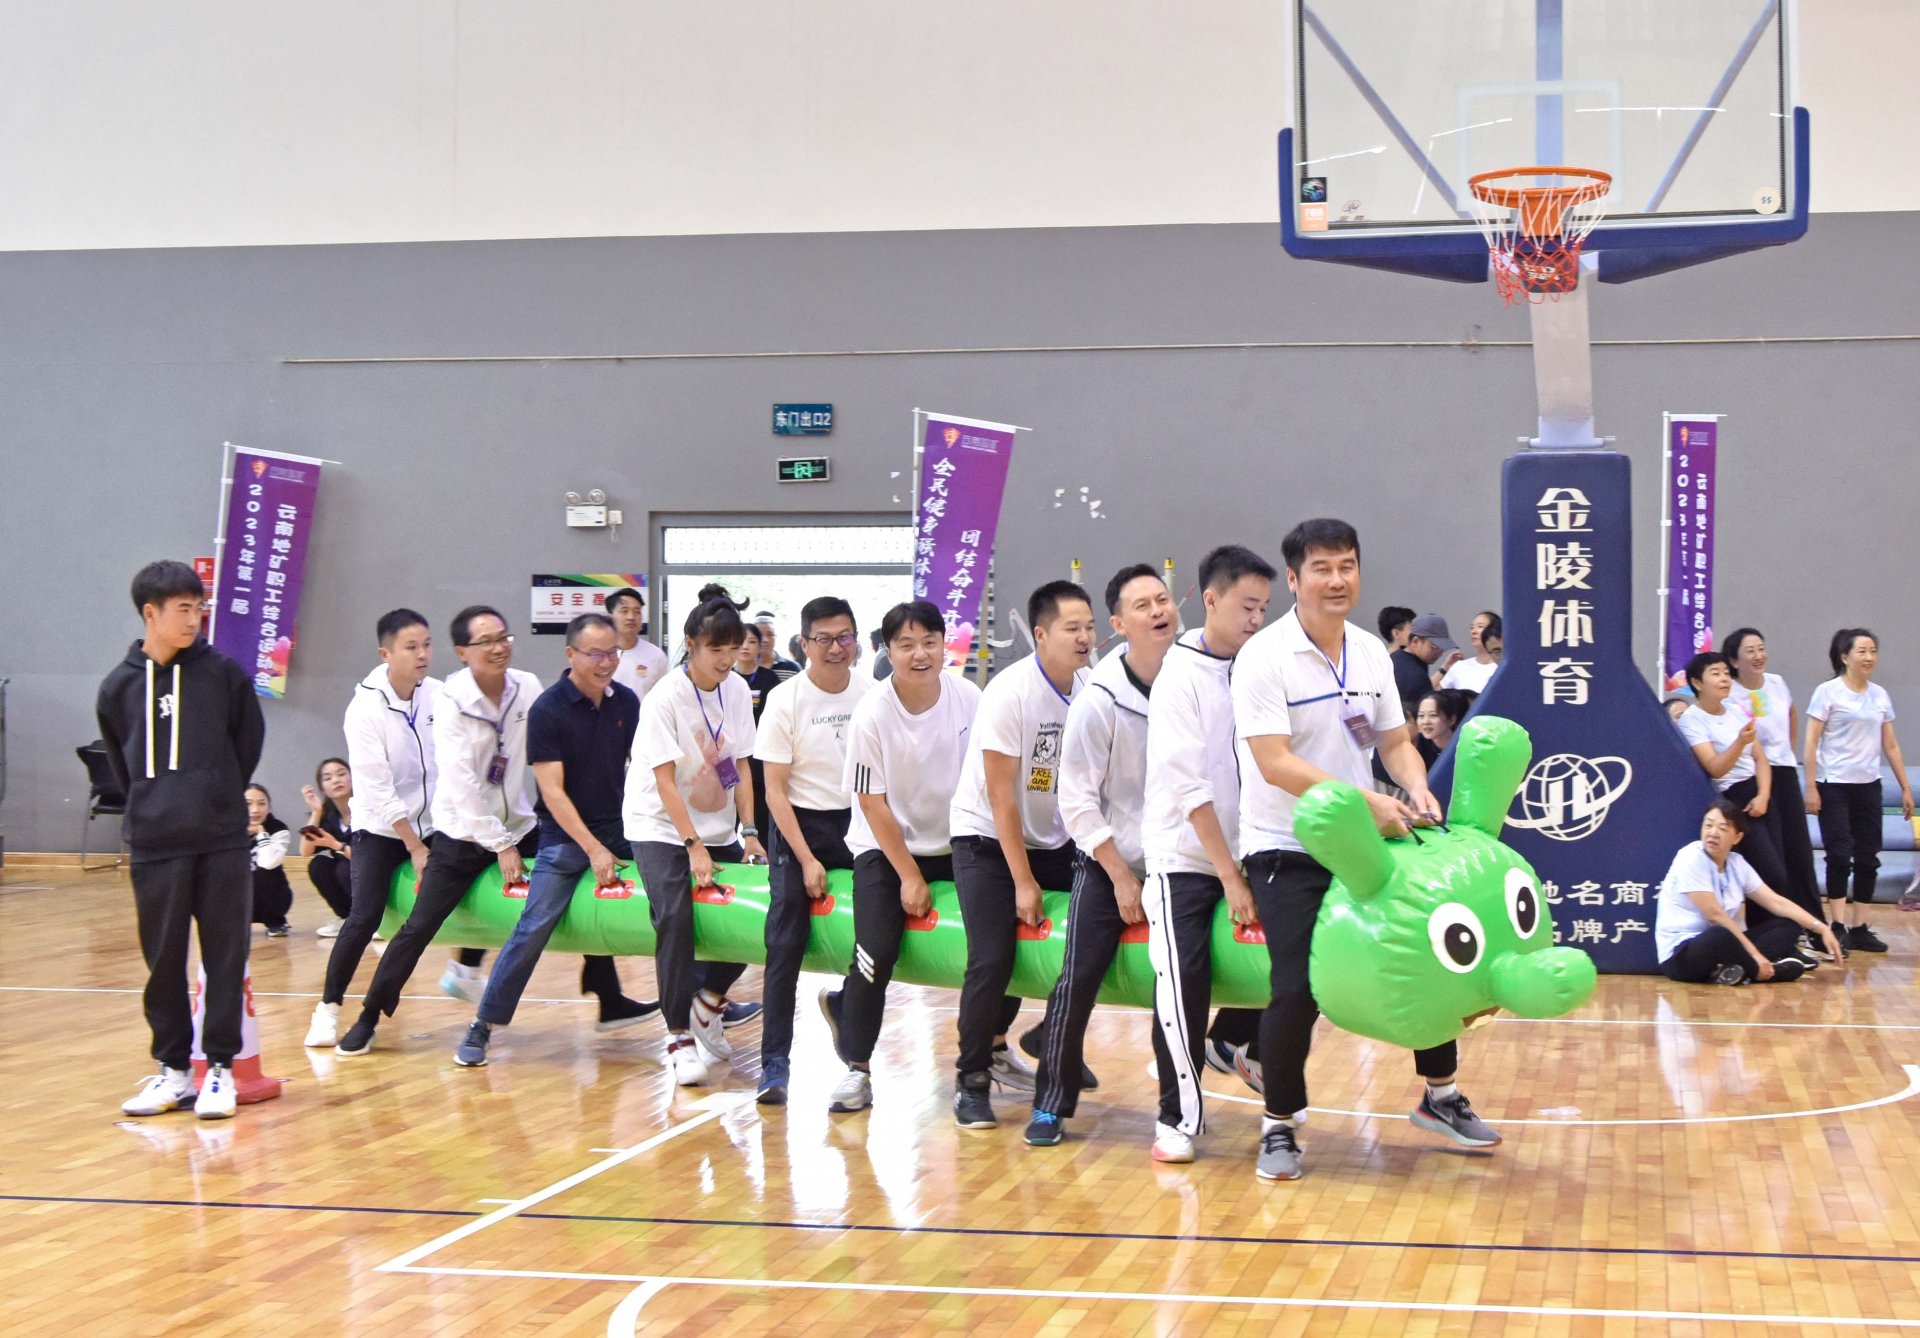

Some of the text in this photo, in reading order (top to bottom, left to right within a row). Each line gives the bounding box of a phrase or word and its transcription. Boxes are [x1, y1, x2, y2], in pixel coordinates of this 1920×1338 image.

[776, 411, 831, 427] 东门出口2
[230, 483, 263, 615] 2023年第一届
[1535, 487, 1594, 705] 金陵体育
[811, 715, 837, 725] LUCKY
[1031, 766, 1053, 778] FREE
[1031, 777, 1049, 785] and
[1542, 880, 1663, 905] 名商
[1552, 918, 1650, 944] 牌产
